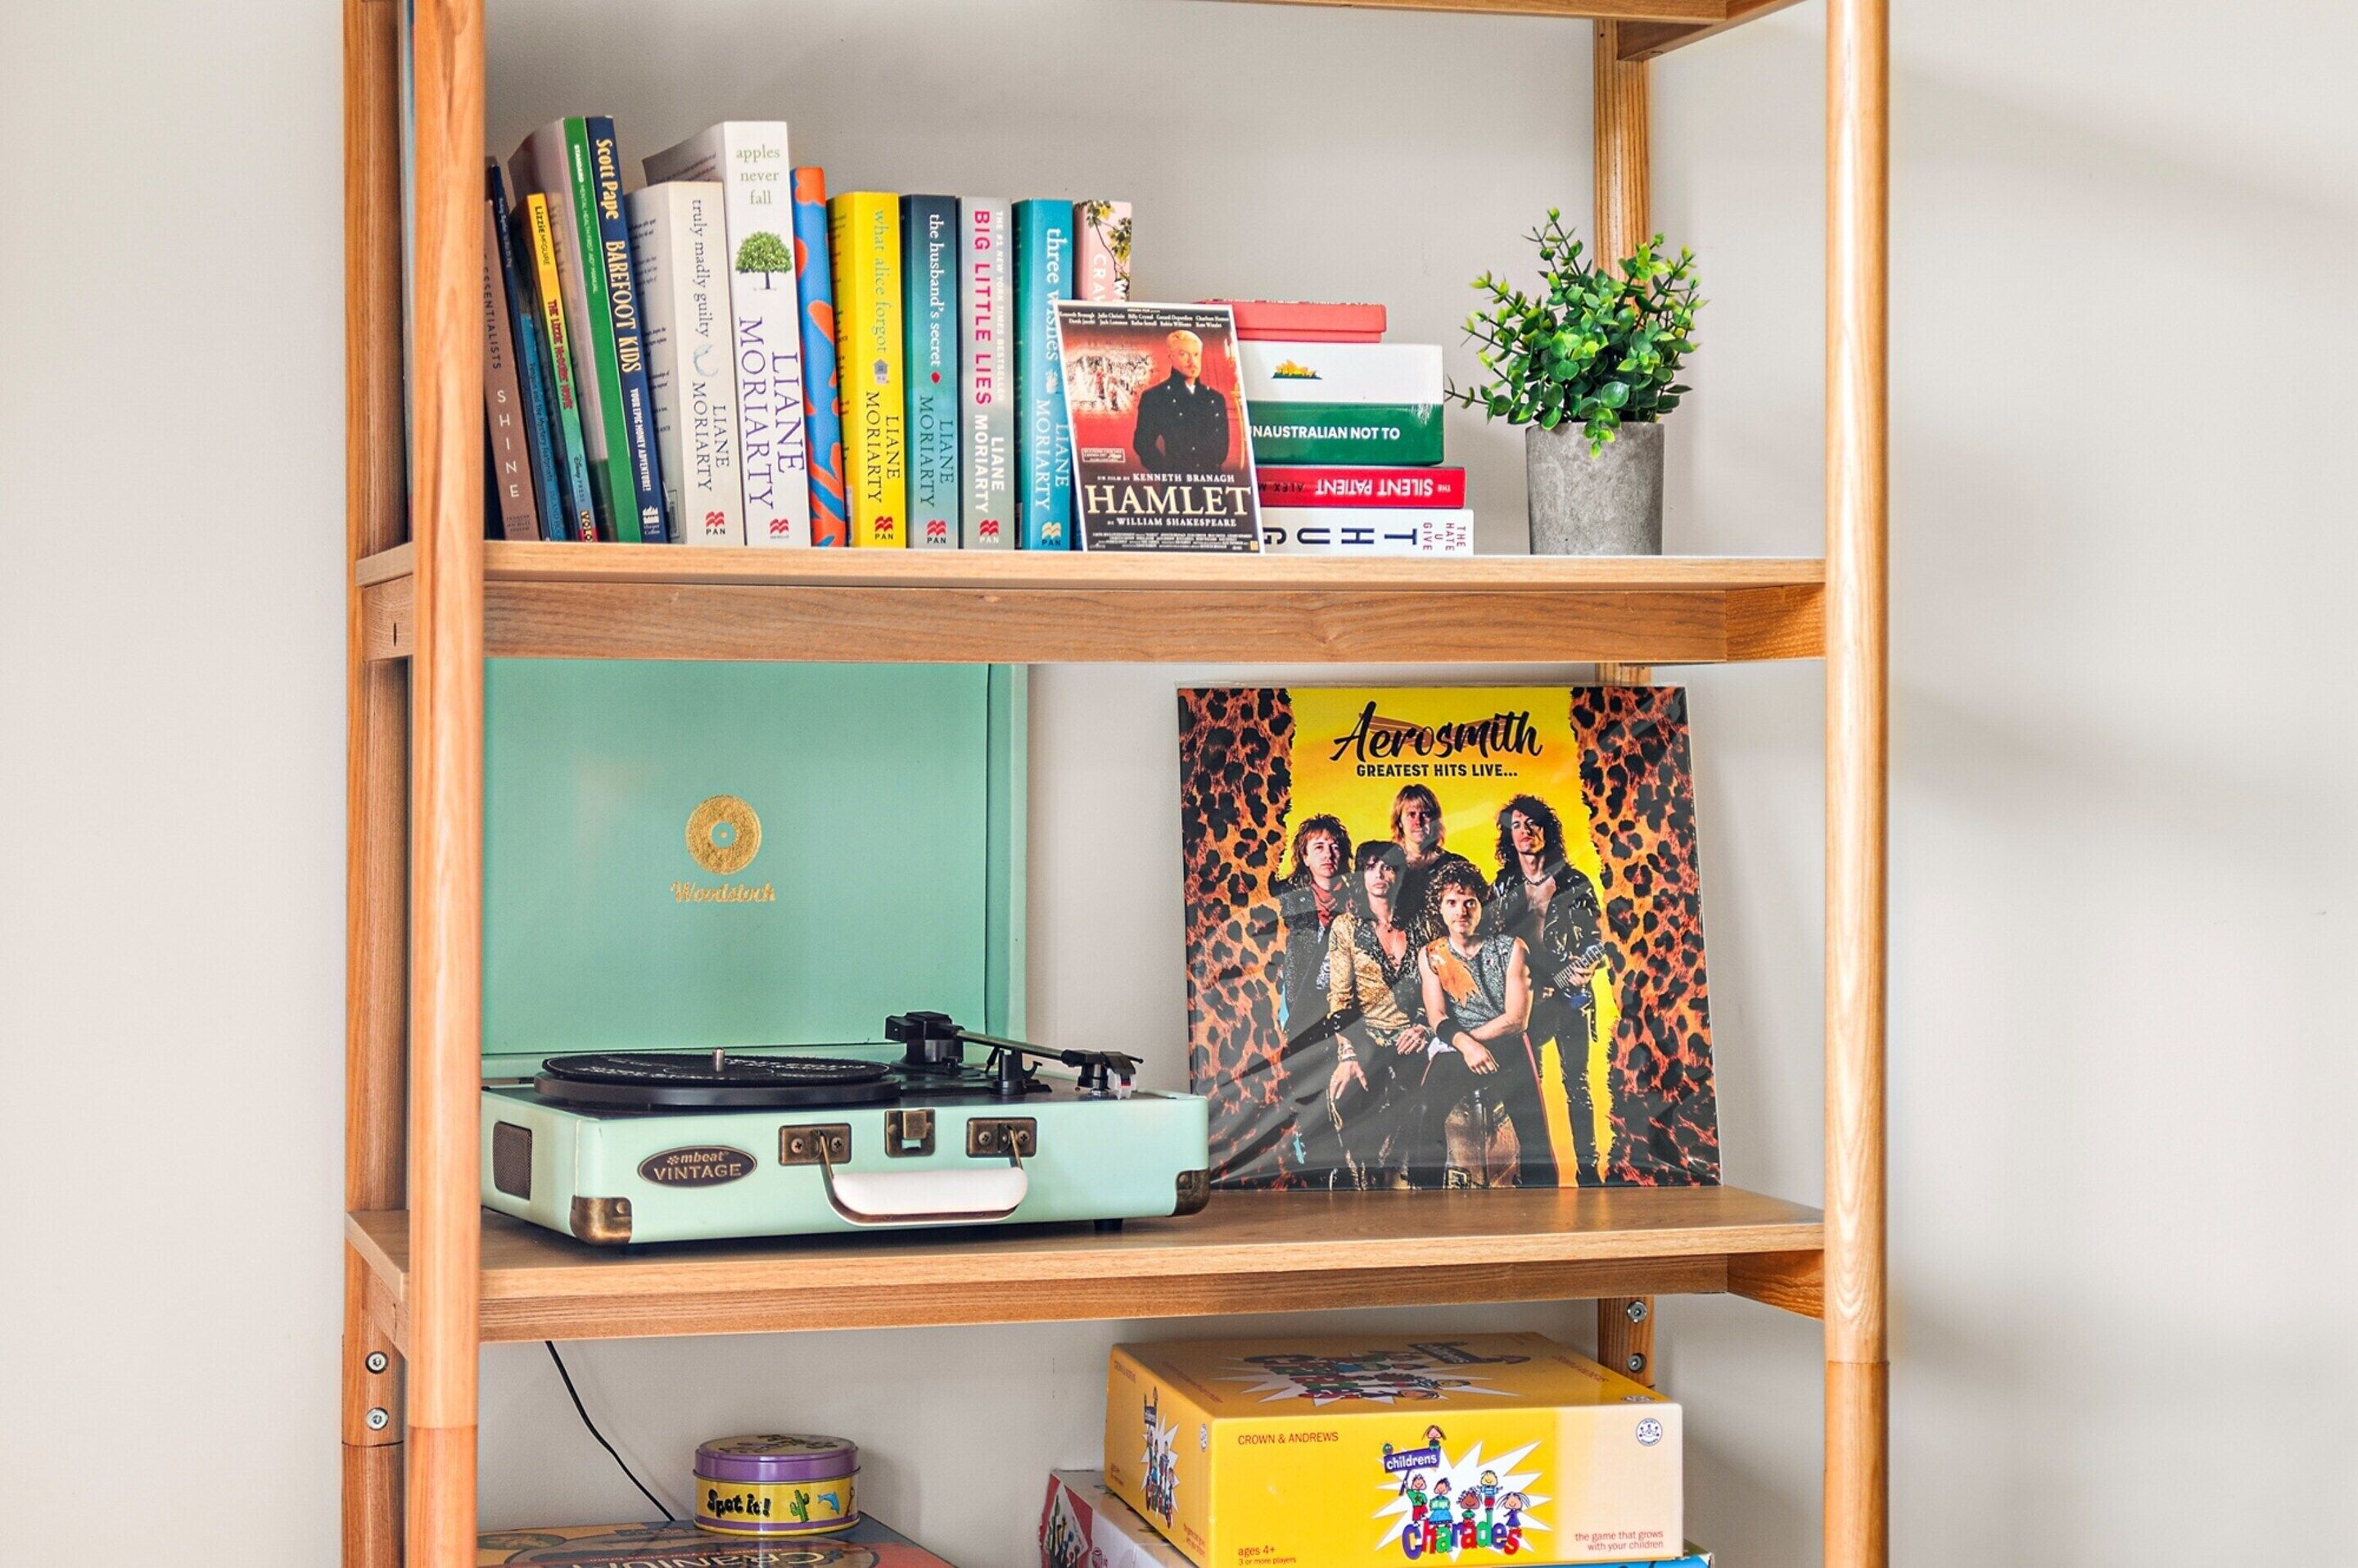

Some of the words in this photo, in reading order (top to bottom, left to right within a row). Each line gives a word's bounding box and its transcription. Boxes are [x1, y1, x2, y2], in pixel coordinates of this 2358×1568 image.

[574, 144, 584, 183] STANDARD
[596, 138, 614, 178] Scott
[736, 144, 780, 163] apples
[740, 172, 779, 182] never
[601, 181, 620, 220] Pape
[749, 190, 772, 205] fall
[690, 200, 707, 237] truly
[874, 210, 889, 251] what
[929, 214, 945, 239] the
[974, 210, 991, 250] BIG
[996, 210, 1004, 231] THE
[996, 234, 1004, 246] #1
[1046, 228, 1068, 283] three
[693, 242, 710, 287] madly
[874, 258, 890, 296] alice
[996, 251, 1004, 273] NEW
[606, 241, 636, 329] BAREFOOT
[929, 242, 945, 319] husband's
[693, 293, 713, 337] guilty
[975, 264, 992, 341] LITTLE
[996, 305, 1005, 335] TIMES
[871, 301, 892, 353] forgot
[930, 322, 941, 367] secret
[618, 337, 642, 373] KIDS
[996, 339, 1005, 402] BESTSELLER
[976, 354, 992, 404] LIES
[630, 388, 640, 408] YOUR
[739, 316, 774, 510] MORIARTY
[771, 351, 805, 473] LIANE
[633, 409, 642, 424] EPIC
[1351, 427, 1380, 440] NOT
[1381, 427, 1401, 440] TO
[497, 389, 520, 498] SHINE
[635, 425, 646, 449] MONEY
[693, 382, 711, 491] MORIARTY
[713, 405, 730, 468] LIANE
[866, 391, 882, 503] MORIARTY
[886, 416, 901, 479] LIANE
[919, 396, 935, 508] MORIARTY
[940, 420, 954, 485] LIANE
[975, 414, 989, 513] MORIARTY
[992, 436, 1005, 491] LIANE
[1035, 399, 1051, 511] MORIARTY
[1055, 423, 1069, 487] LIANE
[1133, 473, 1182, 481] KENNETH
[1187, 474, 1235, 482] BRANAGH
[1274, 483, 1304, 492] ALEX
[1315, 478, 1372, 495] PATIENT
[1377, 478, 1434, 496] SILENT
[1085, 485, 1252, 516] HAMLET
[1117, 517, 1163, 526] WILLIAM
[1166, 517, 1237, 527] SHAKESPEARE
[1263, 527, 1417, 546] THUG
[1422, 522, 1433, 551] GIVE
[1445, 522, 1455, 551] HATE
[1457, 526, 1466, 548] THE
[1329, 701, 1543, 762] Aerosmith
[1356, 764, 1429, 777] GREATEST
[1434, 764, 1467, 777] HITS
[670, 880, 776, 903] Woodstock
[653, 1163, 742, 1181] VINTAGE
[1238, 1435, 1275, 1445] CROWN
[1277, 1434, 1285, 1444] &
[1289, 1432, 1339, 1443] ANDREWS
[1386, 1453, 1438, 1471] childrens
[707, 1489, 743, 1518] Spot
[746, 1493, 772, 1518] it!
[1238, 1547, 1261, 1557] ages
[1263, 1545, 1276, 1554] 4+
[1402, 1508, 1523, 1561] Charades
[1575, 1532, 1590, 1542] the
[1592, 1533, 1616, 1543] game
[1618, 1531, 1636, 1539] that
[1638, 1530, 1664, 1540] grows
[1588, 1542, 1606, 1551] with
[1608, 1543, 1627, 1552] your
[1628, 1540, 1664, 1550] children
[1272, 1557, 1297, 1566] players
